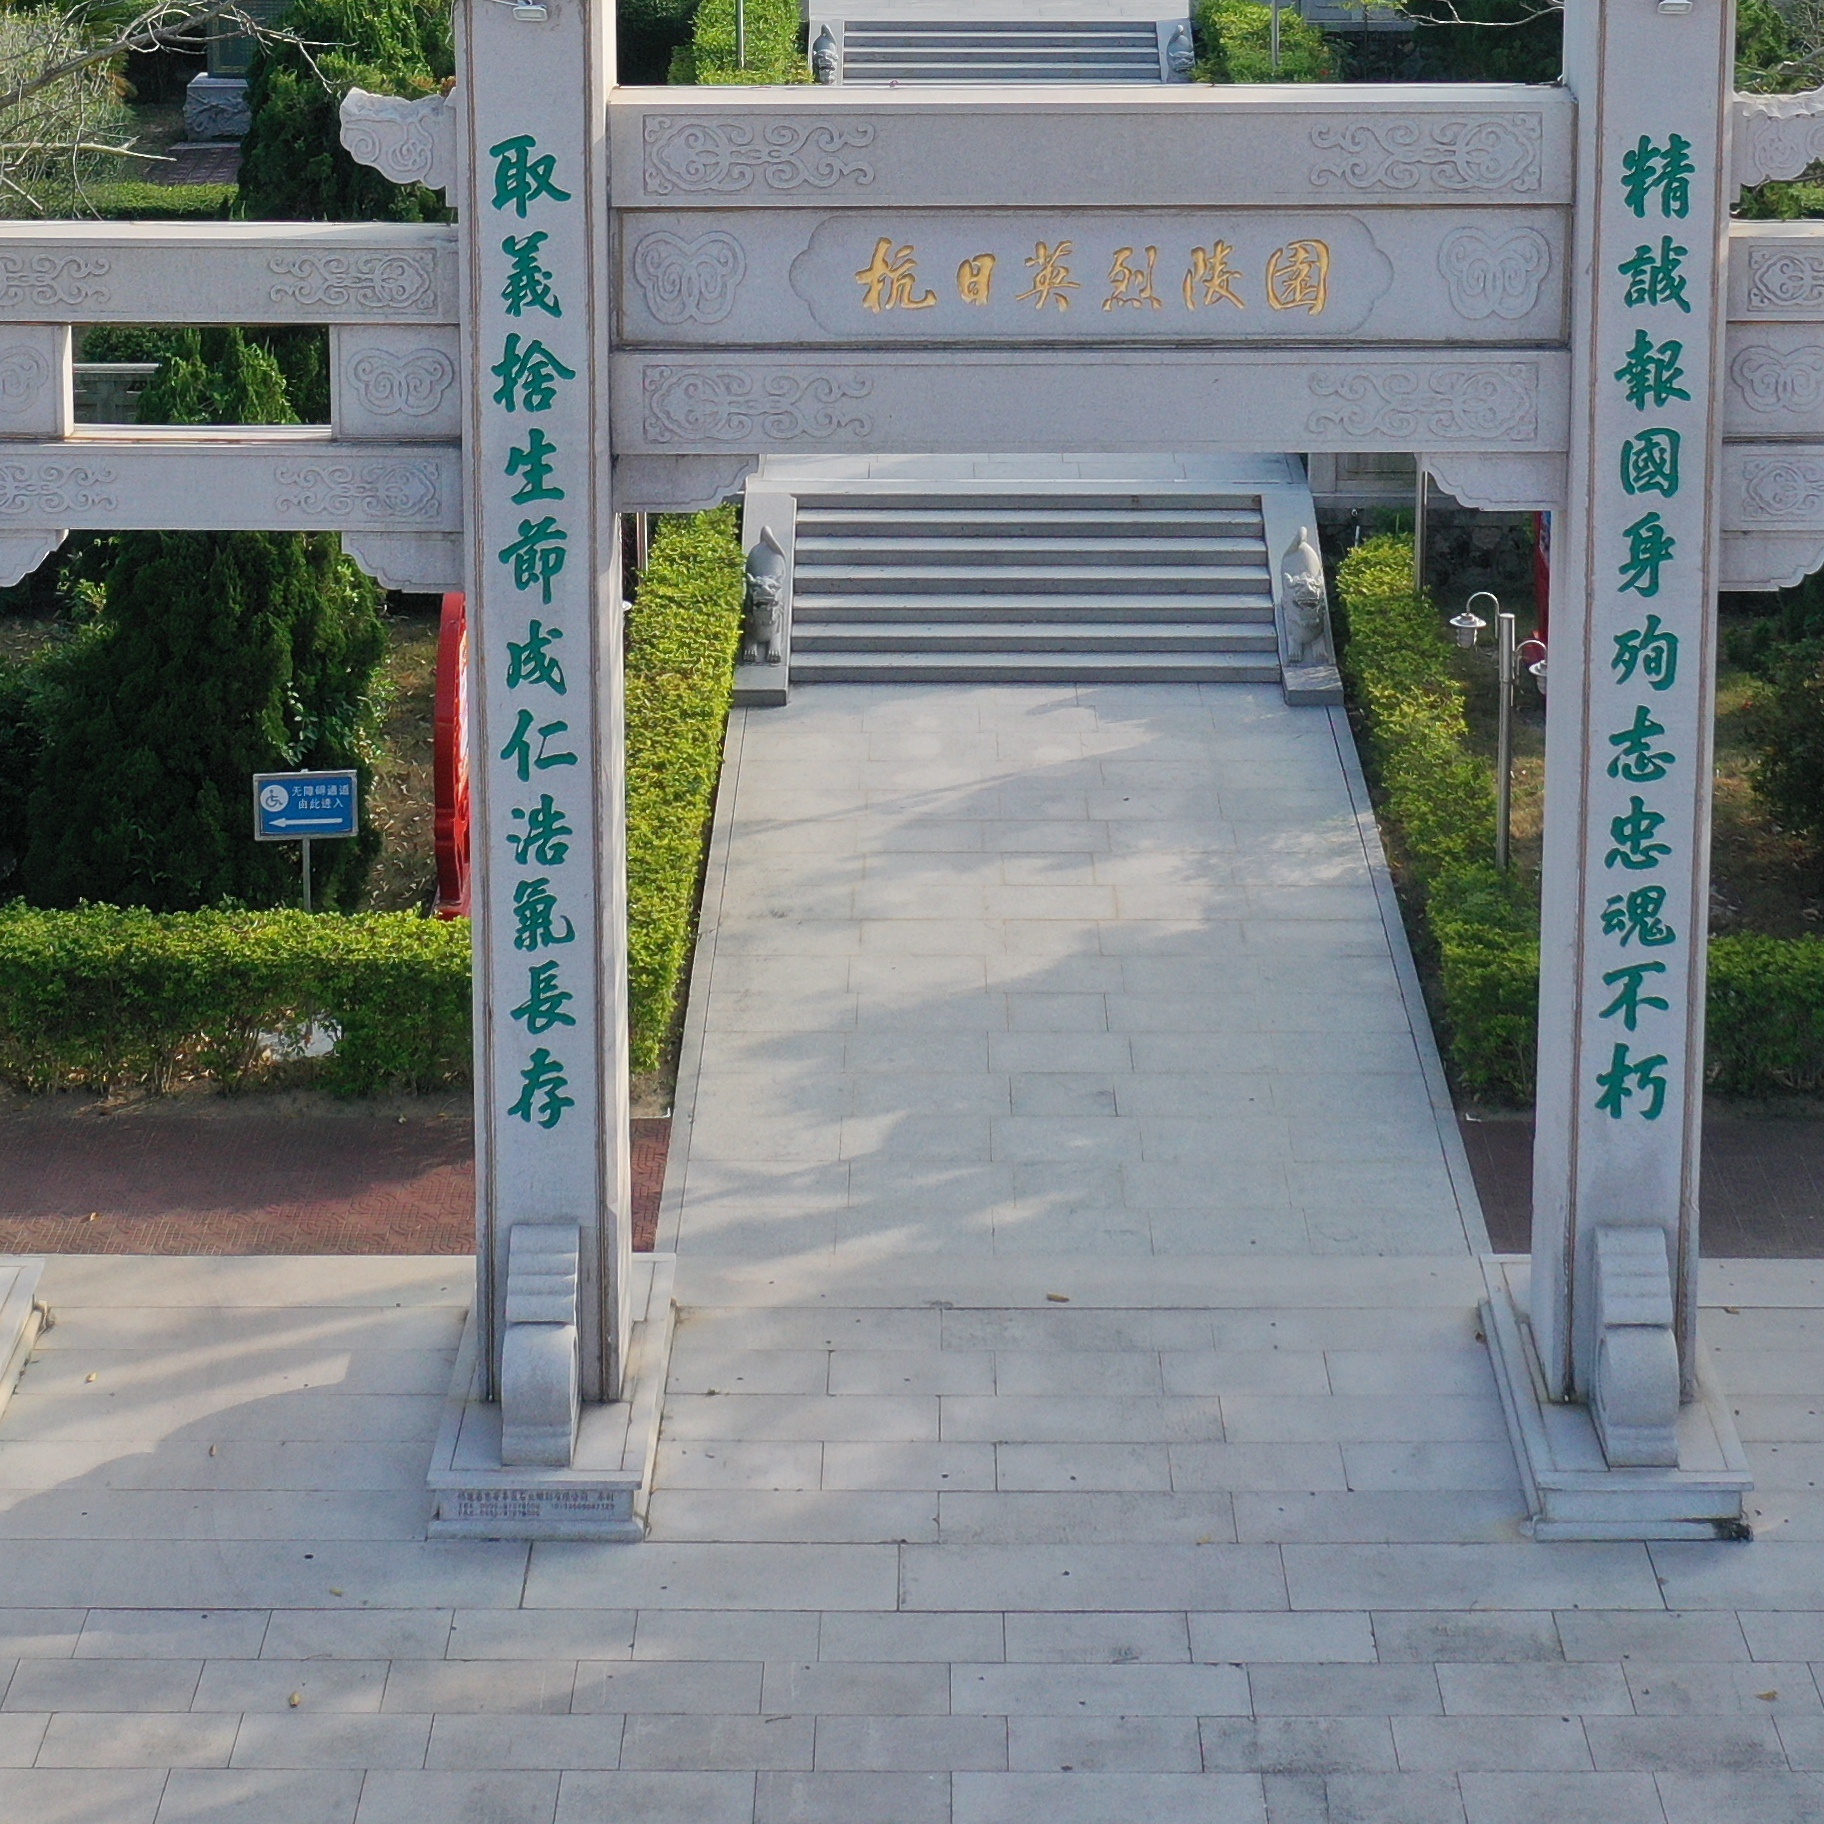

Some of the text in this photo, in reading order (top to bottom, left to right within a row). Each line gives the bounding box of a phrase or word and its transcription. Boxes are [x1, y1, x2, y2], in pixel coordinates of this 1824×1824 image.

[854, 236, 1331, 315] 抗日英烈陵園
[291, 784, 350, 797] 无障碍通道
[298, 798, 344, 810] 由此进入
